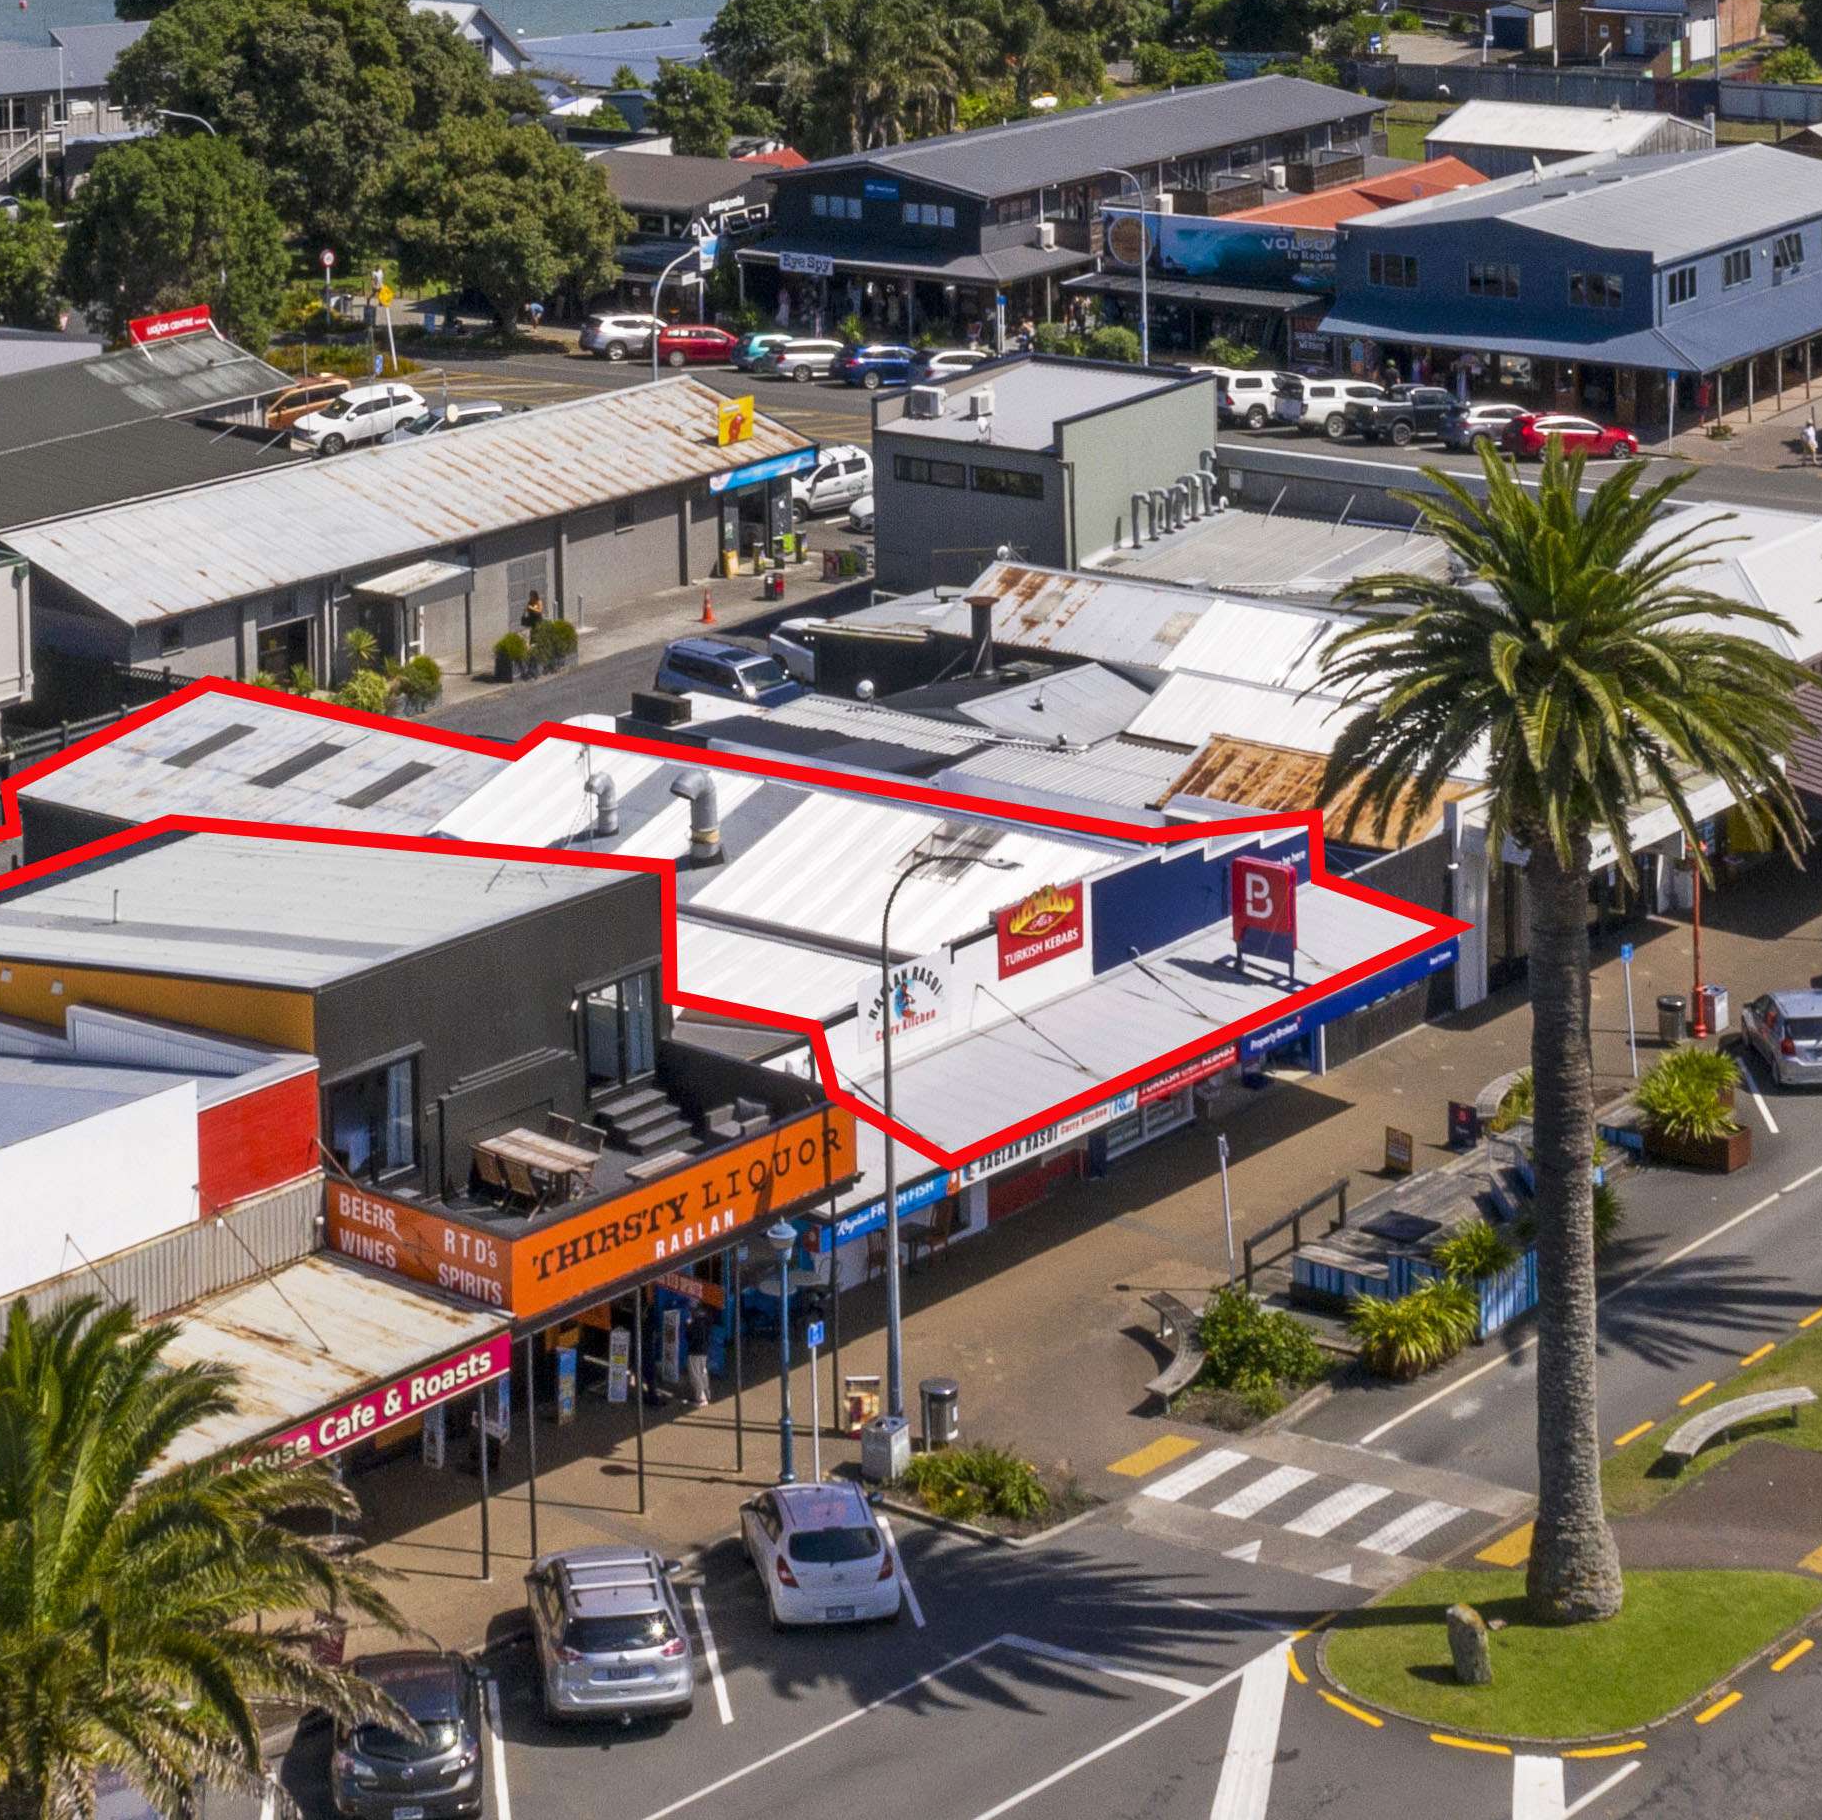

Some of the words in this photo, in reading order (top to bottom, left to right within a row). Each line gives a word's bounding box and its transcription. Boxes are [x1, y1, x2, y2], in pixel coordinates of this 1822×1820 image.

[782, 253, 806, 270] Eye
[808, 255, 831, 273] Spy
[1245, 872, 1274, 919] B
[1003, 940, 1044, 968] TURKISH
[1044, 926, 1080, 952] KEBABS
[911, 965, 943, 996] RASOI
[979, 1141, 1021, 1174] RAGLAN
[1025, 1125, 1059, 1154] RASOI
[339, 1192, 396, 1232] BEERS
[532, 1192, 689, 1281] THIRSTY
[702, 1127, 843, 1211] LIQUOR
[339, 1227, 397, 1270] WINES
[656, 1208, 735, 1260] RAGLAN
[438, 1262, 503, 1307] SPIRITS
[318, 1403, 377, 1448] Cafe
[383, 1386, 403, 1418] &
[410, 1350, 493, 1406] Roasts
